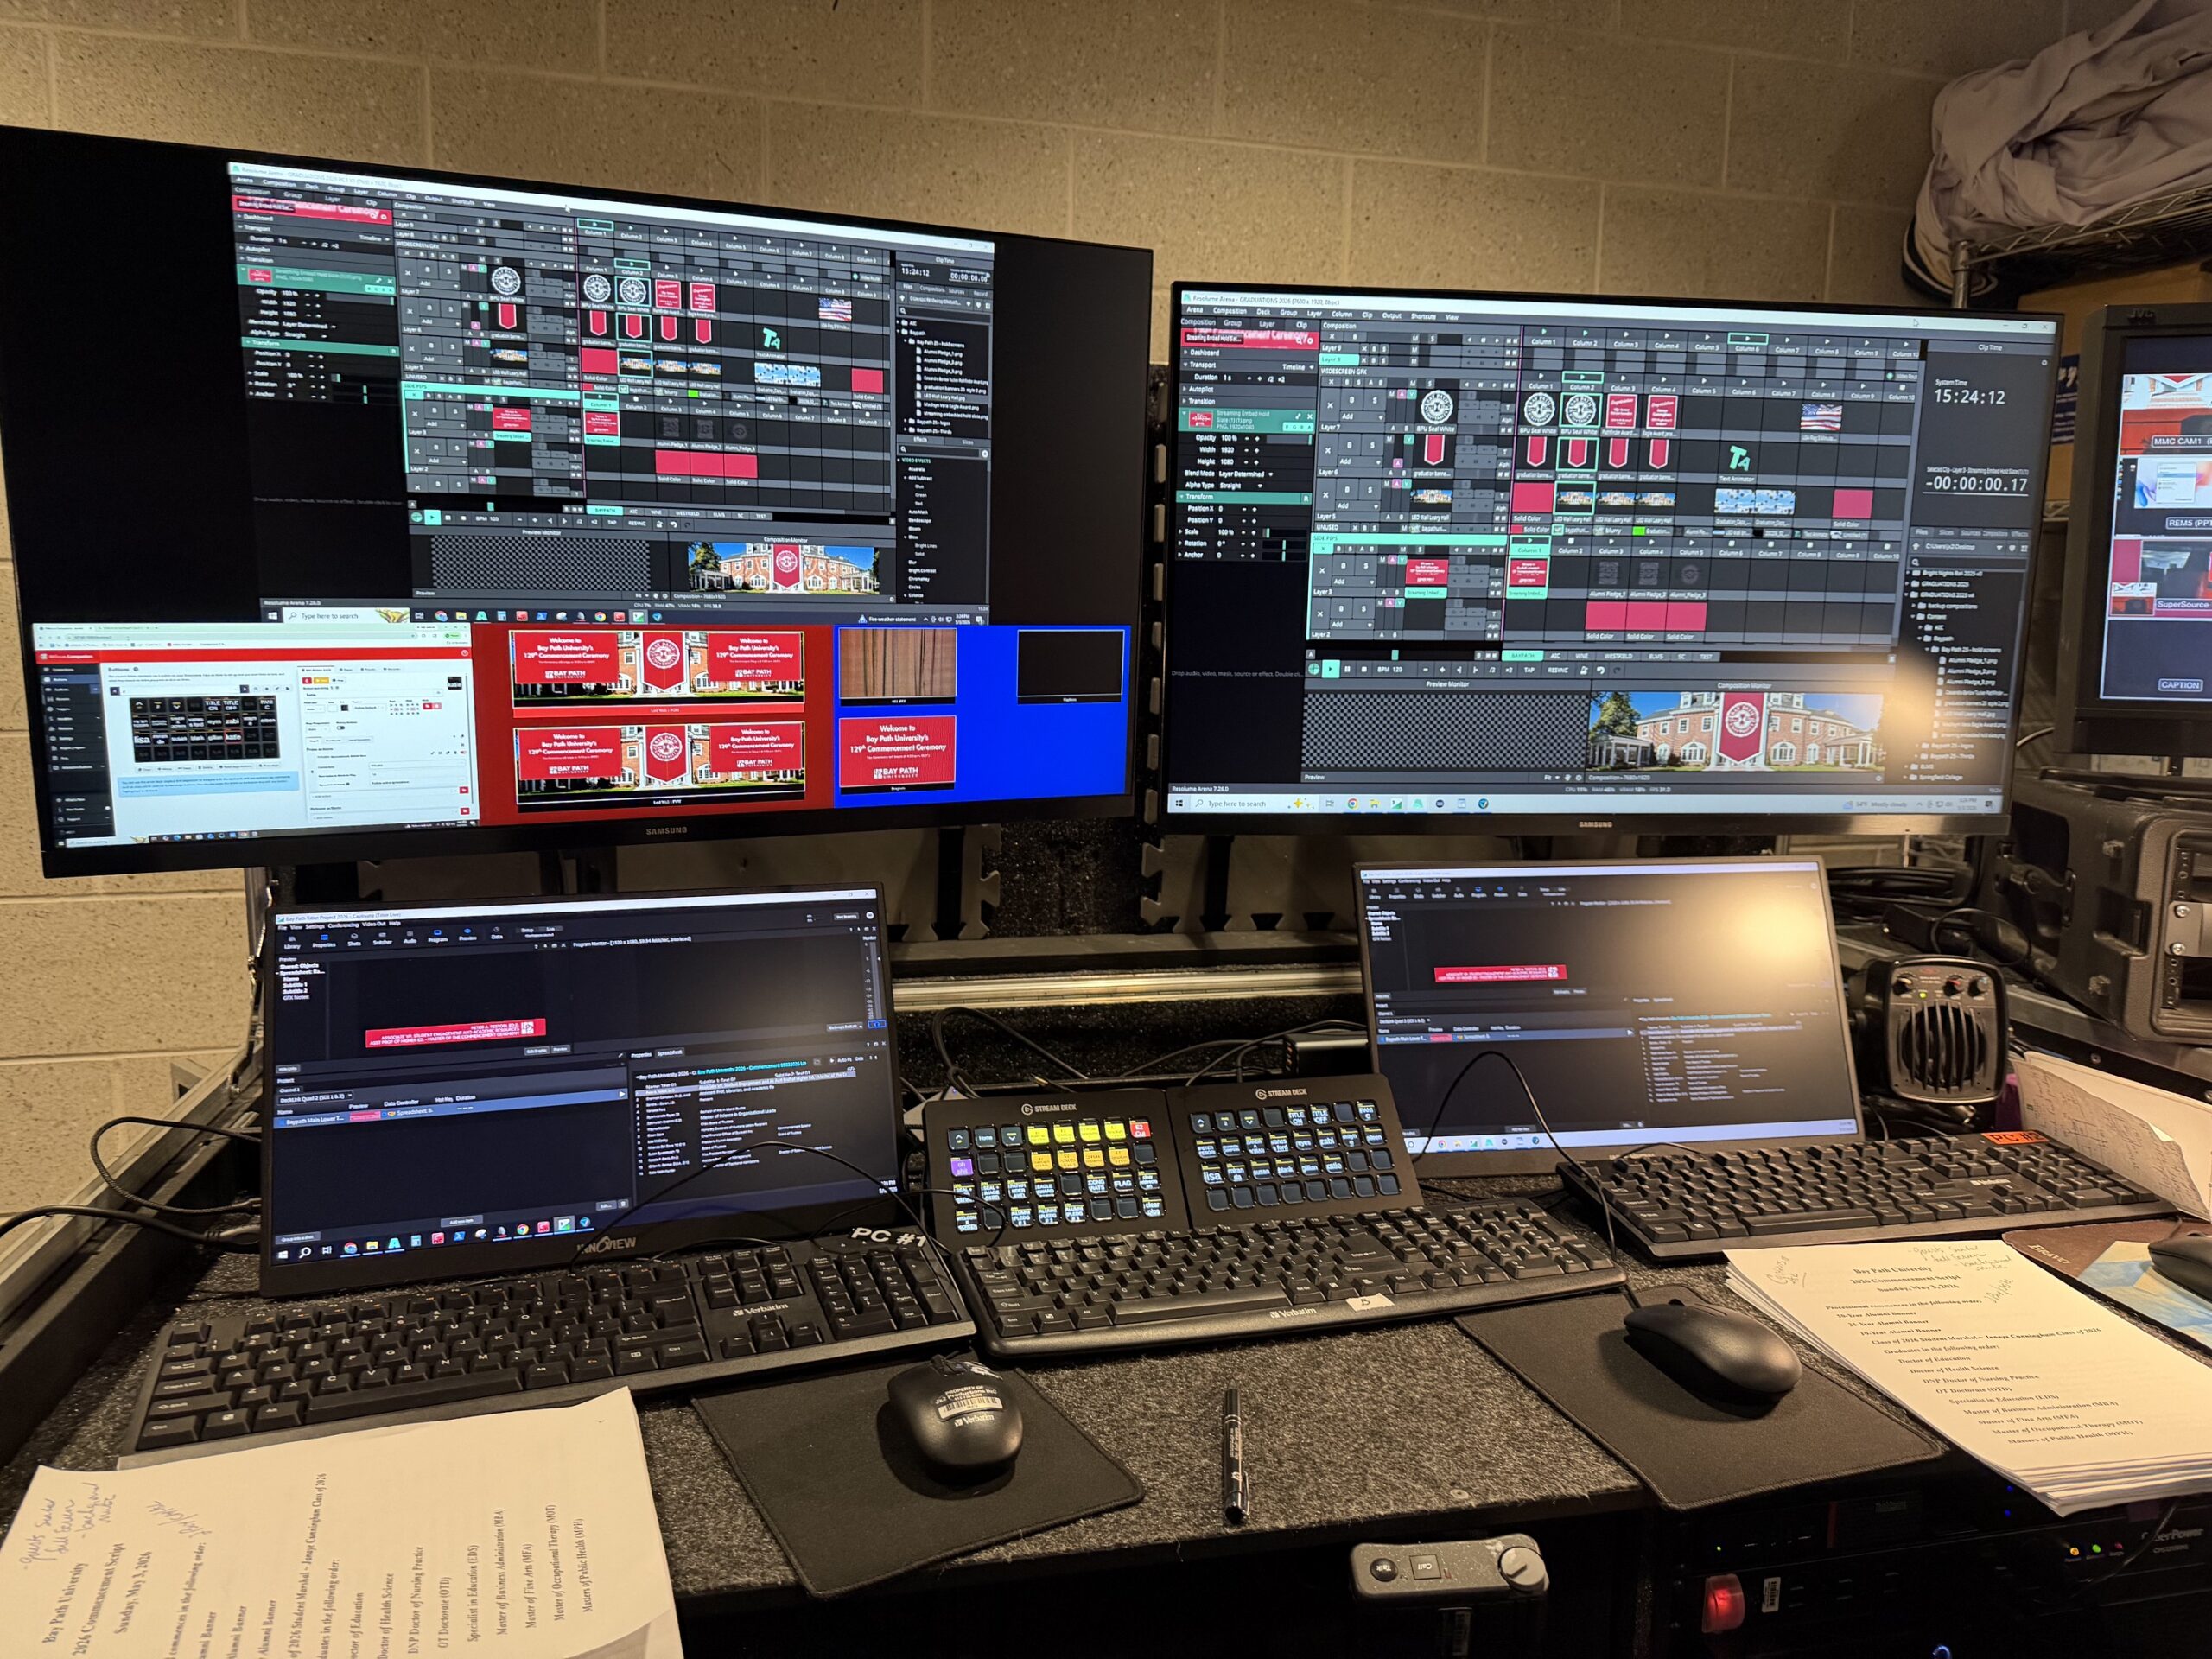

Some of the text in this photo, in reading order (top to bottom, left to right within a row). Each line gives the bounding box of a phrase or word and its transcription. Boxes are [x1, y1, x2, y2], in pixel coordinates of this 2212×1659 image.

[1213, 307, 1247, 315] Composition
[1190, 361, 1217, 370] Transport
[1935, 389, 2005, 405] 15:24:12
[1925, 476, 2028, 493] -00:00:00.17
[2161, 680, 2200, 690] CAPTION
[894, 734, 929, 742] University's
[645, 826, 688, 836] SAMSUNG
[1268, 1088, 1307, 1097] STREAM DECK
[1990, 1132, 2044, 1143] PC #2
[851, 1227, 928, 1248] PC #1
[1872, 1275, 1935, 1284] Commencement
[743, 1301, 789, 1316] Verbatim
[1279, 1306, 1317, 1319] Verbatim
[944, 1385, 975, 1395] PROPERTY
[2037, 1402, 2091, 1411] Administration
[963, 1413, 995, 1425] Verbatim
[315, 1472, 327, 1485] 2026
[312, 1491, 322, 1508] Class
[305, 1509, 321, 1544] Cunningham
[2141, 1528, 2203, 1542] CerPower
[136, 1551, 152, 1570] 2026
[302, 1545, 317, 1565] Janaye
[467, 1545, 480, 1564] (EDS)
[545, 1504, 566, 1621] Master of Occupational Therapy (MOT)
[494, 1509, 509, 1635] Master of Business Administration (MBA)
[574, 1518, 593, 1612] Masters of Public Health (MPH)
[126, 1579, 146, 1599] May
[296, 1572, 310, 1601] Marshal
[467, 1565, 478, 1596] Education
[42, 1562, 88, 1643] Bay Path University
[73, 1542, 126, 1656] 2026 Commencement Script
[169, 1541, 207, 1656] commences in the following order:
[408, 1547, 425, 1654] DNP Doctor of Nursing Practice
[115, 1598, 139, 1634] Sunday,
[292, 1601, 306, 1629] Student
[438, 1577, 452, 1648] OT Doctorate (OTD)
[467, 1608, 480, 1642] Specialist
[289, 1630, 302, 1647] 2026
